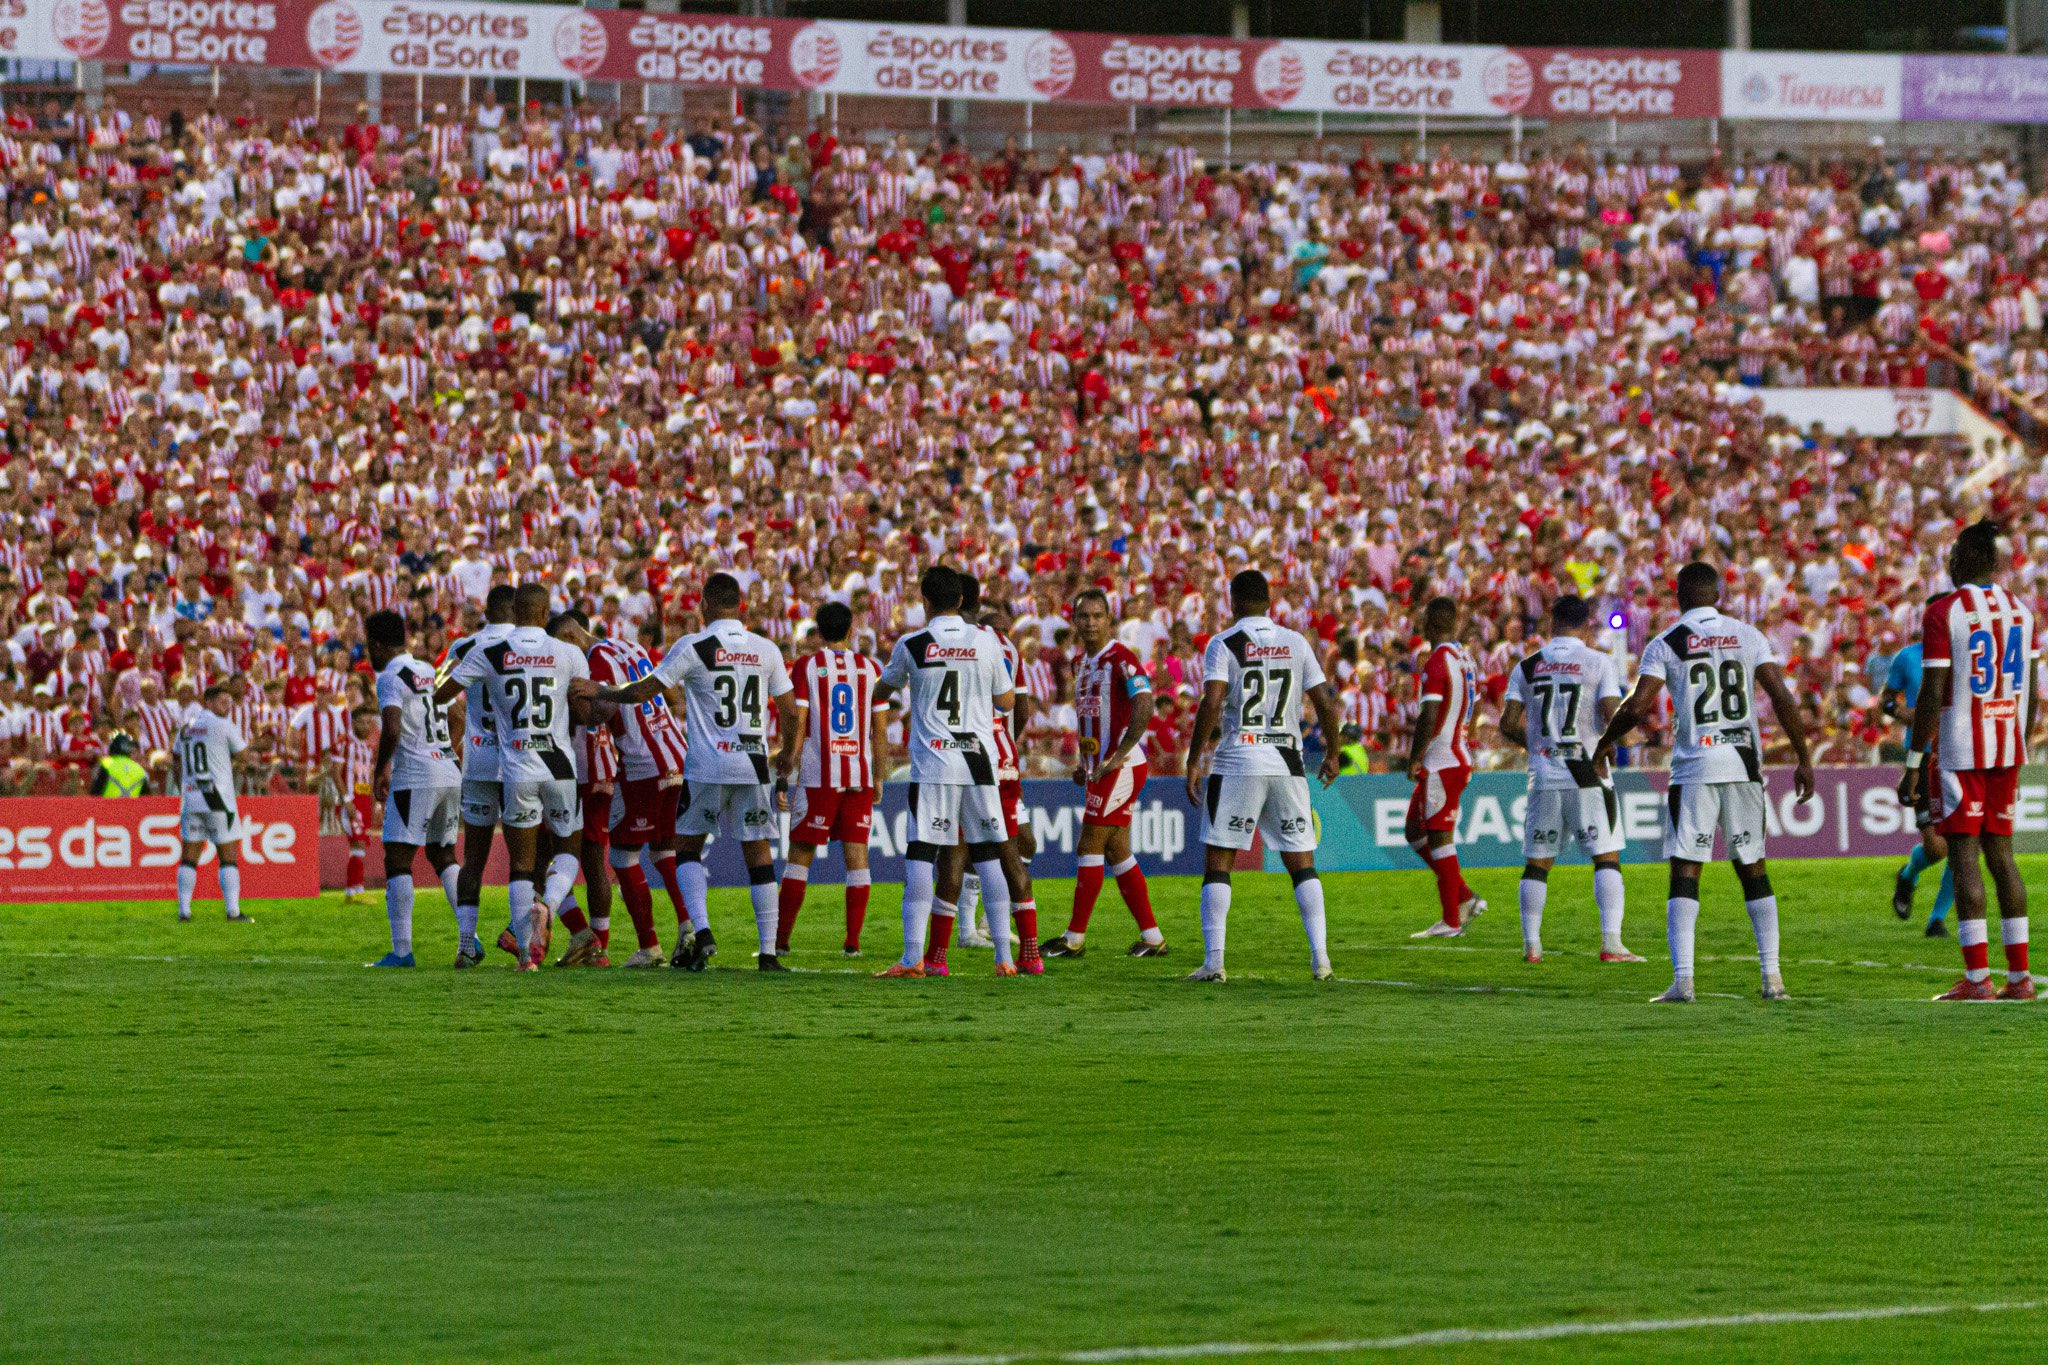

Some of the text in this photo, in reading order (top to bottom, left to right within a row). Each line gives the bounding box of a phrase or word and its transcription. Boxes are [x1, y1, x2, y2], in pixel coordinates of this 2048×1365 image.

[120, 0, 277, 31] Esportes
[382, 6, 529, 45] Esportes
[174, 28, 267, 63] Sorte
[628, 17, 772, 52] Esportes
[867, 32, 1008, 62] Esportes
[435, 40, 521, 70] Sorte
[680, 51, 764, 83] Sorte
[1103, 41, 1242, 72] Esportes
[1326, 50, 1462, 80] Esportes
[1543, 54, 1682, 84] Esportes
[917, 62, 1000, 93] Sorte
[1153, 70, 1235, 102] Sorte
[1374, 80, 1455, 108] Sorte
[1593, 83, 1674, 113] Sorte
[716, 648, 759, 663] CORTAG
[926, 643, 976, 658] CORTAG
[1246, 642, 1290, 657] CORTAG
[1688, 634, 1737, 650] CORTAG
[503, 651, 555, 666] CORTAG
[1534, 660, 1580, 673] CORTAG
[1969, 626, 2023, 694] 34
[505, 677, 554, 730] 25
[714, 674, 761, 728] 34
[831, 683, 855, 734] 8
[937, 670, 960, 726] 4
[1242, 668, 1291, 727] 27
[1690, 660, 1747, 725] 28
[422, 696, 449, 743] 15
[1533, 683, 1581, 736] 77
[185, 742, 209, 776] 10
[59, 817, 131, 868] da
[1131, 800, 1184, 861] idp
